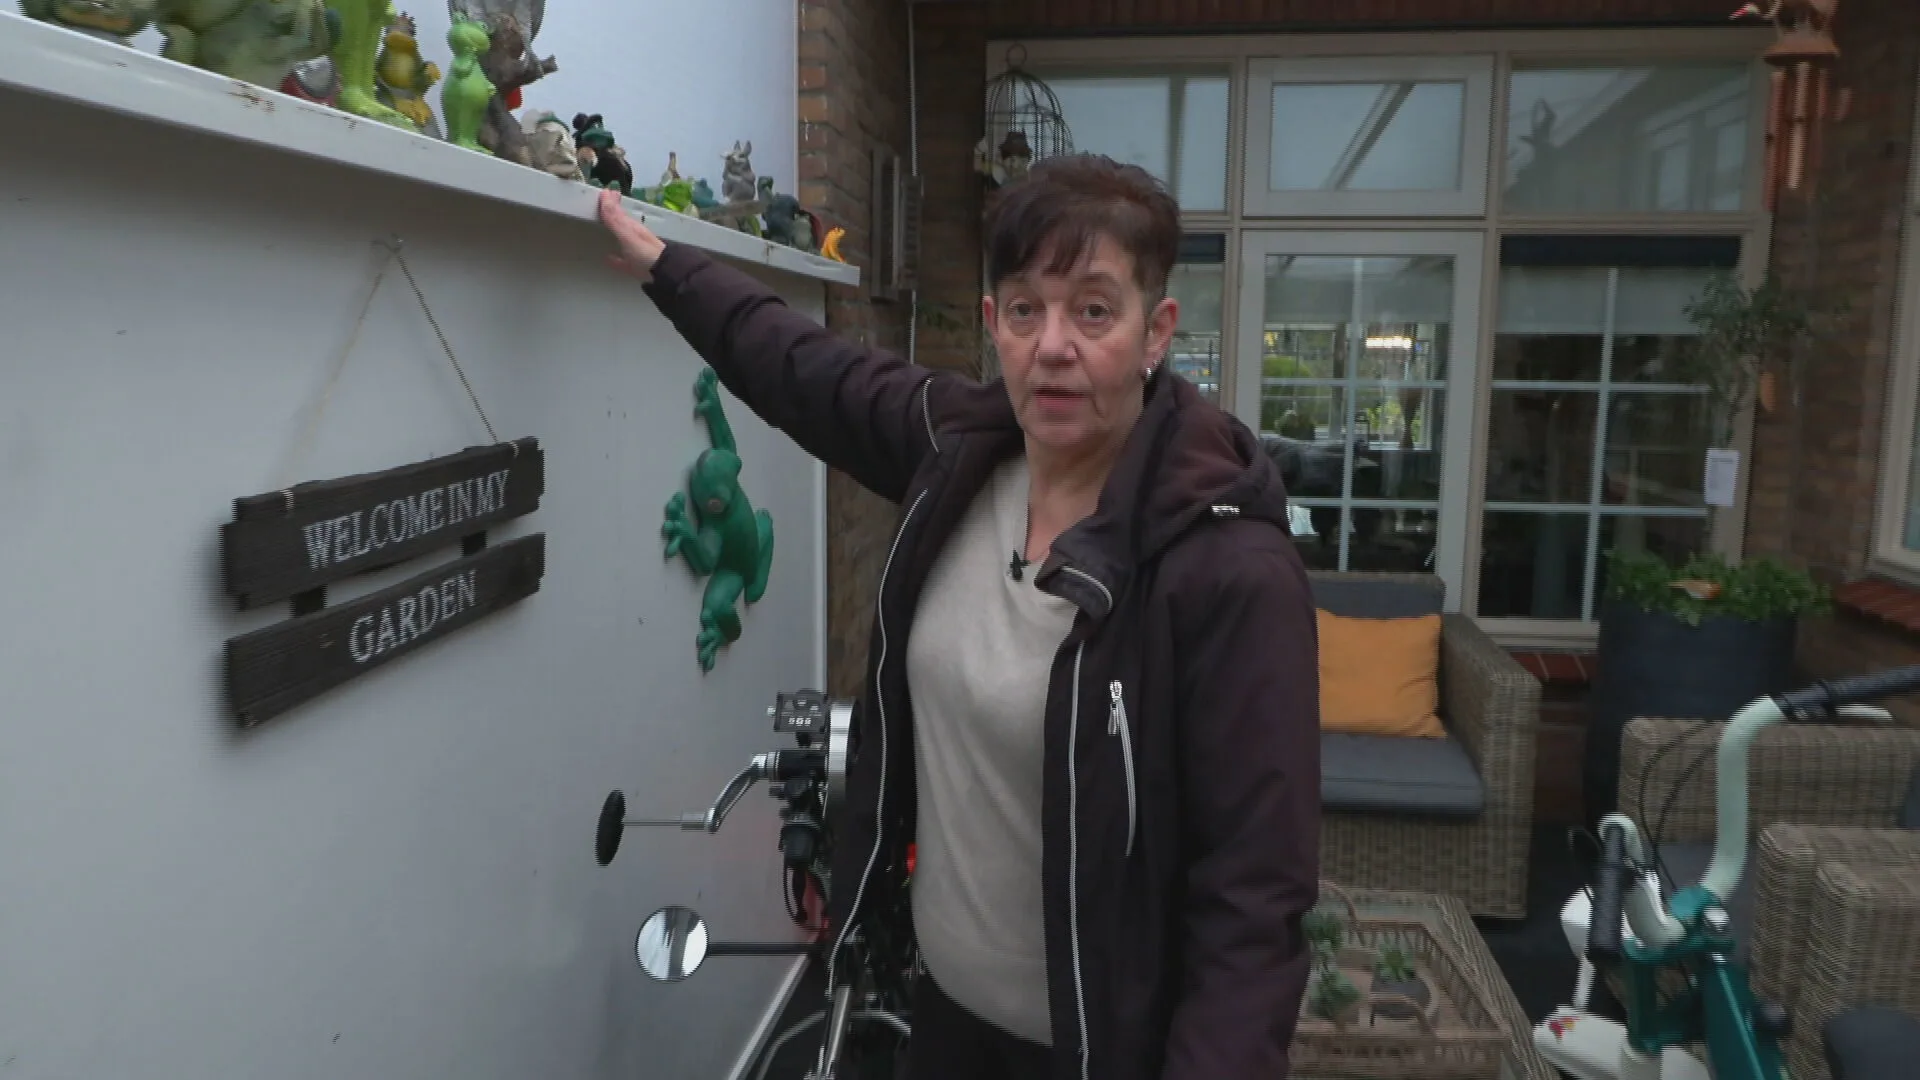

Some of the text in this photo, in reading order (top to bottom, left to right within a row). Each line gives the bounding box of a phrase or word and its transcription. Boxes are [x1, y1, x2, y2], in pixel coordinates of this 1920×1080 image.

[303, 469, 510, 570] WELCOME IN MY
[350, 570, 477, 664] GARDEN
